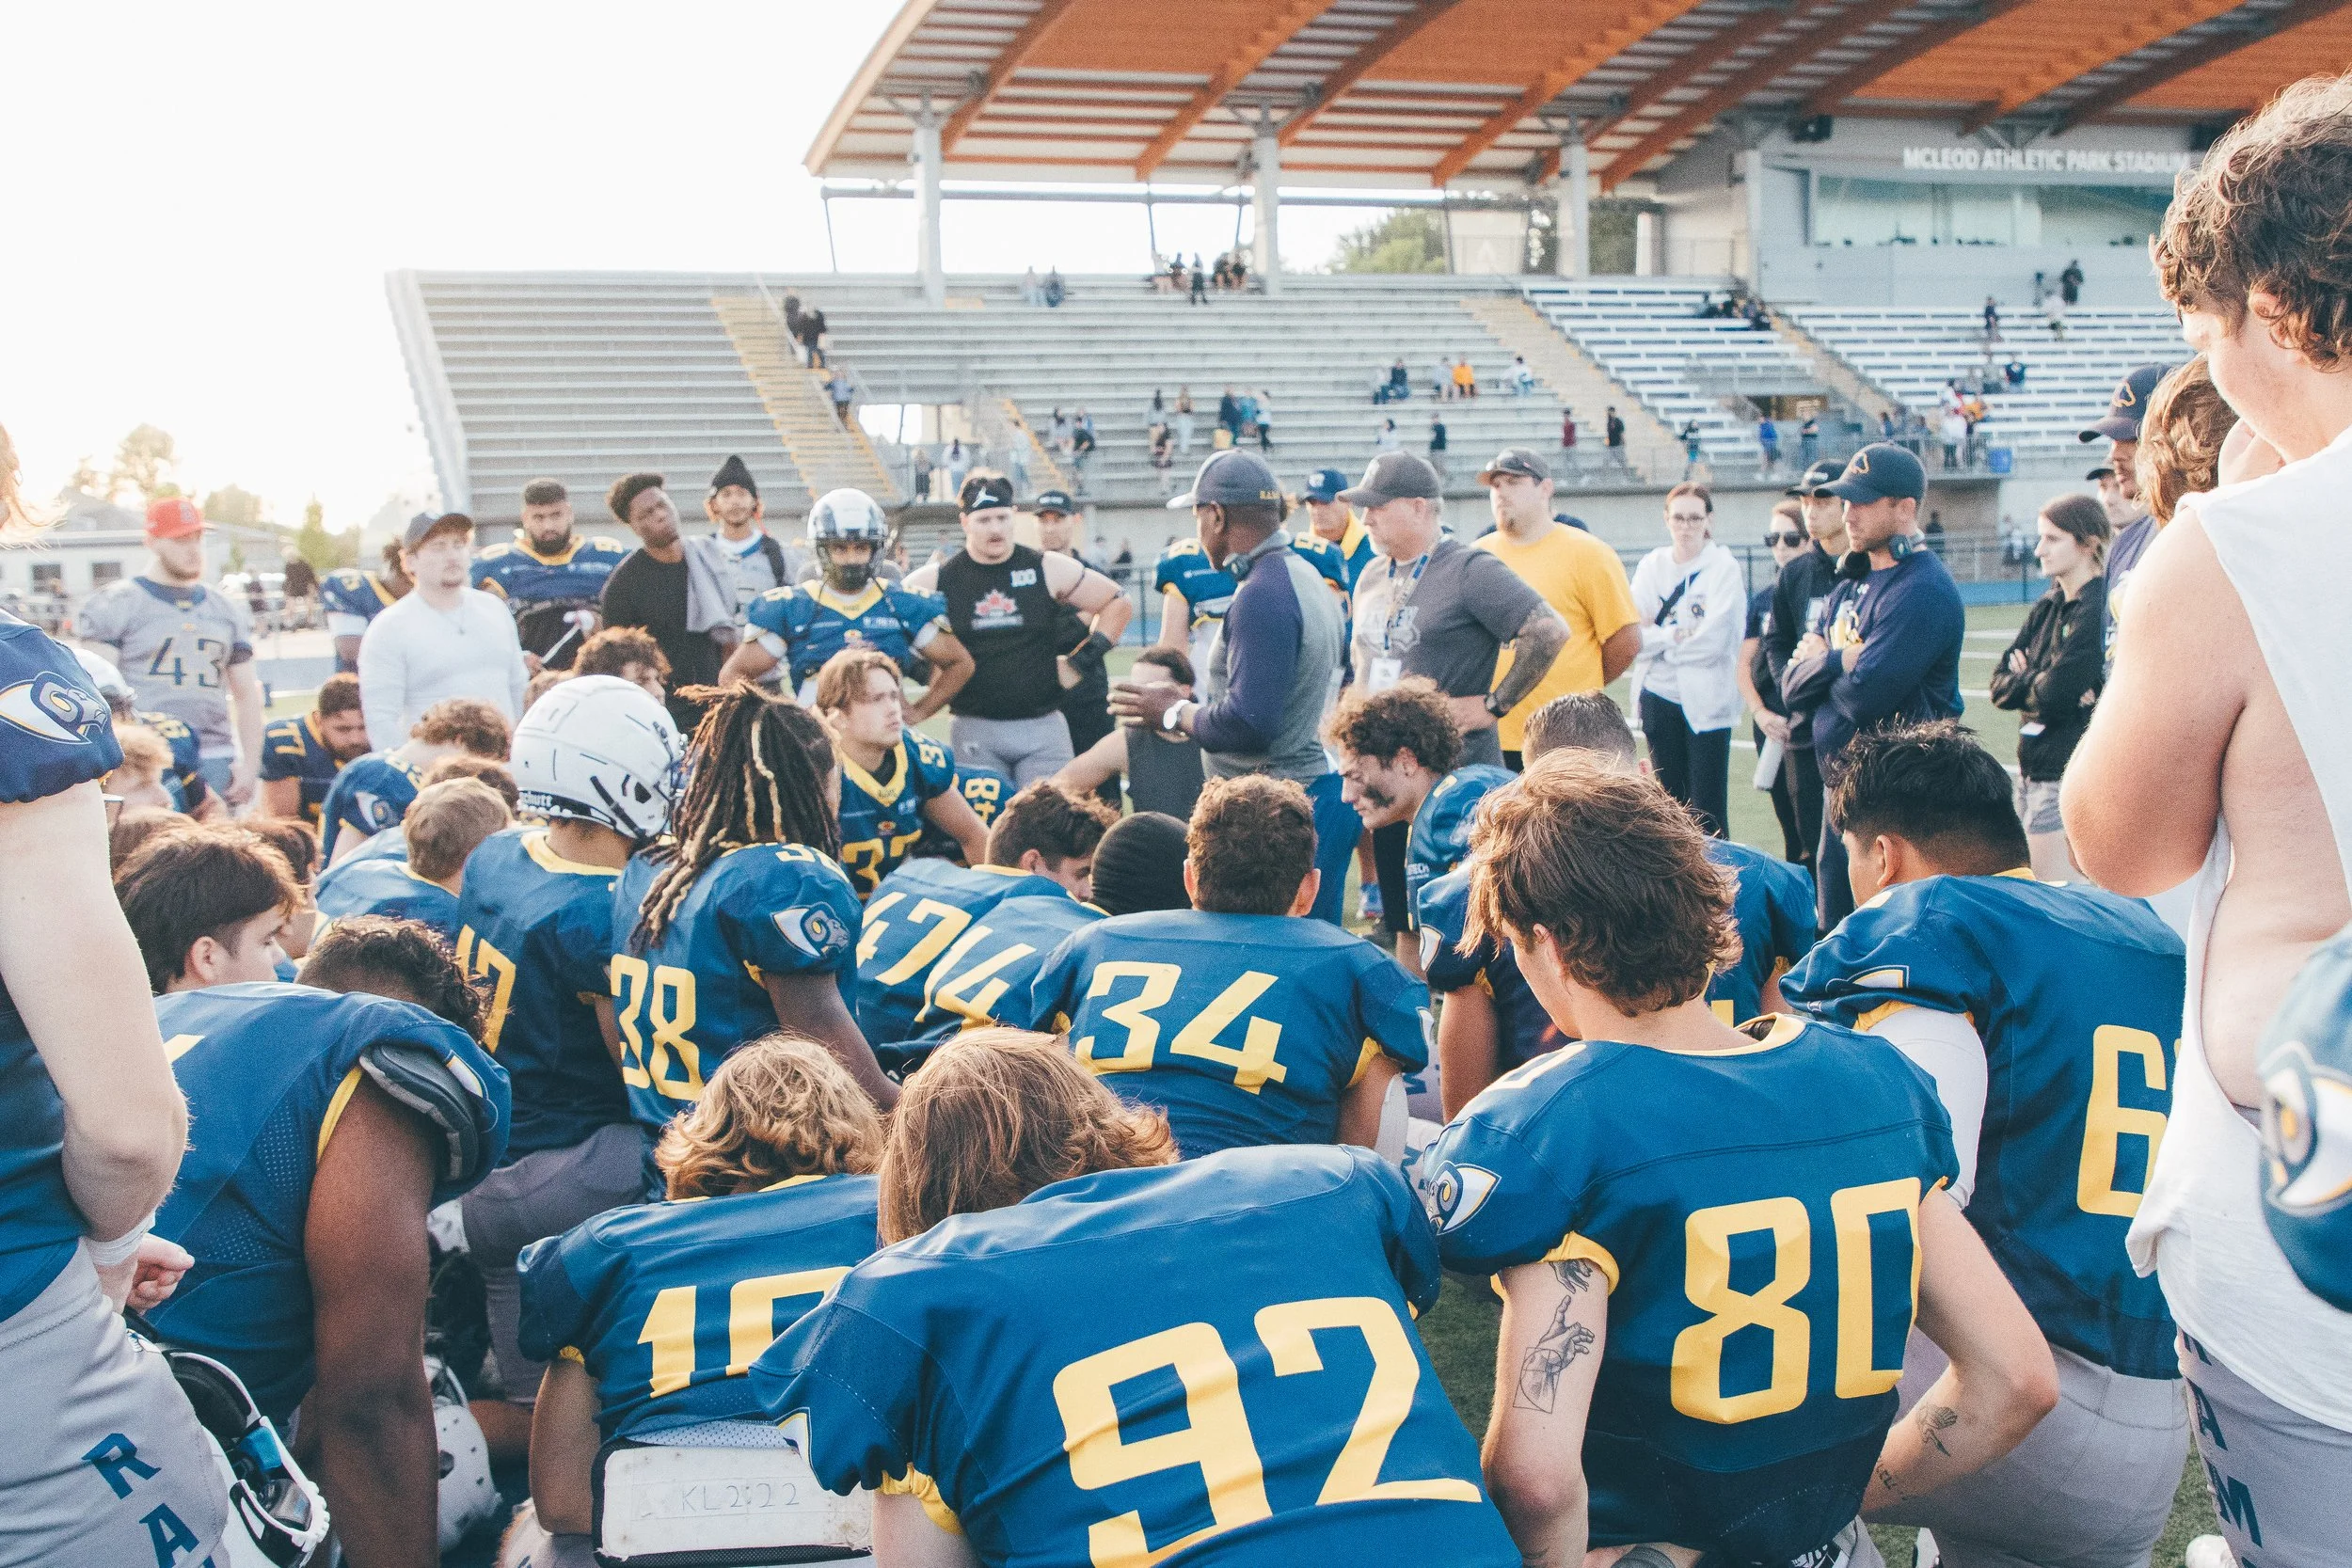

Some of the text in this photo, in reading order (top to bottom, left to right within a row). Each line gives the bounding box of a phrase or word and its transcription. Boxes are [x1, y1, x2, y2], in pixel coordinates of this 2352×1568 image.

[1903, 147, 2192, 173] MCLEOD ATHLETIC PARK STADIUM
[147, 636, 226, 689] 43
[855, 892, 973, 986] 47
[914, 925, 1037, 1031] 14
[610, 953, 706, 1101] 38
[1075, 960, 1288, 1096] 34
[2076, 1023, 2182, 1218] 6
[1670, 1176, 1923, 1425] 80
[1052, 1296, 1483, 1568] 92
[81, 1433, 216, 1568] RA
